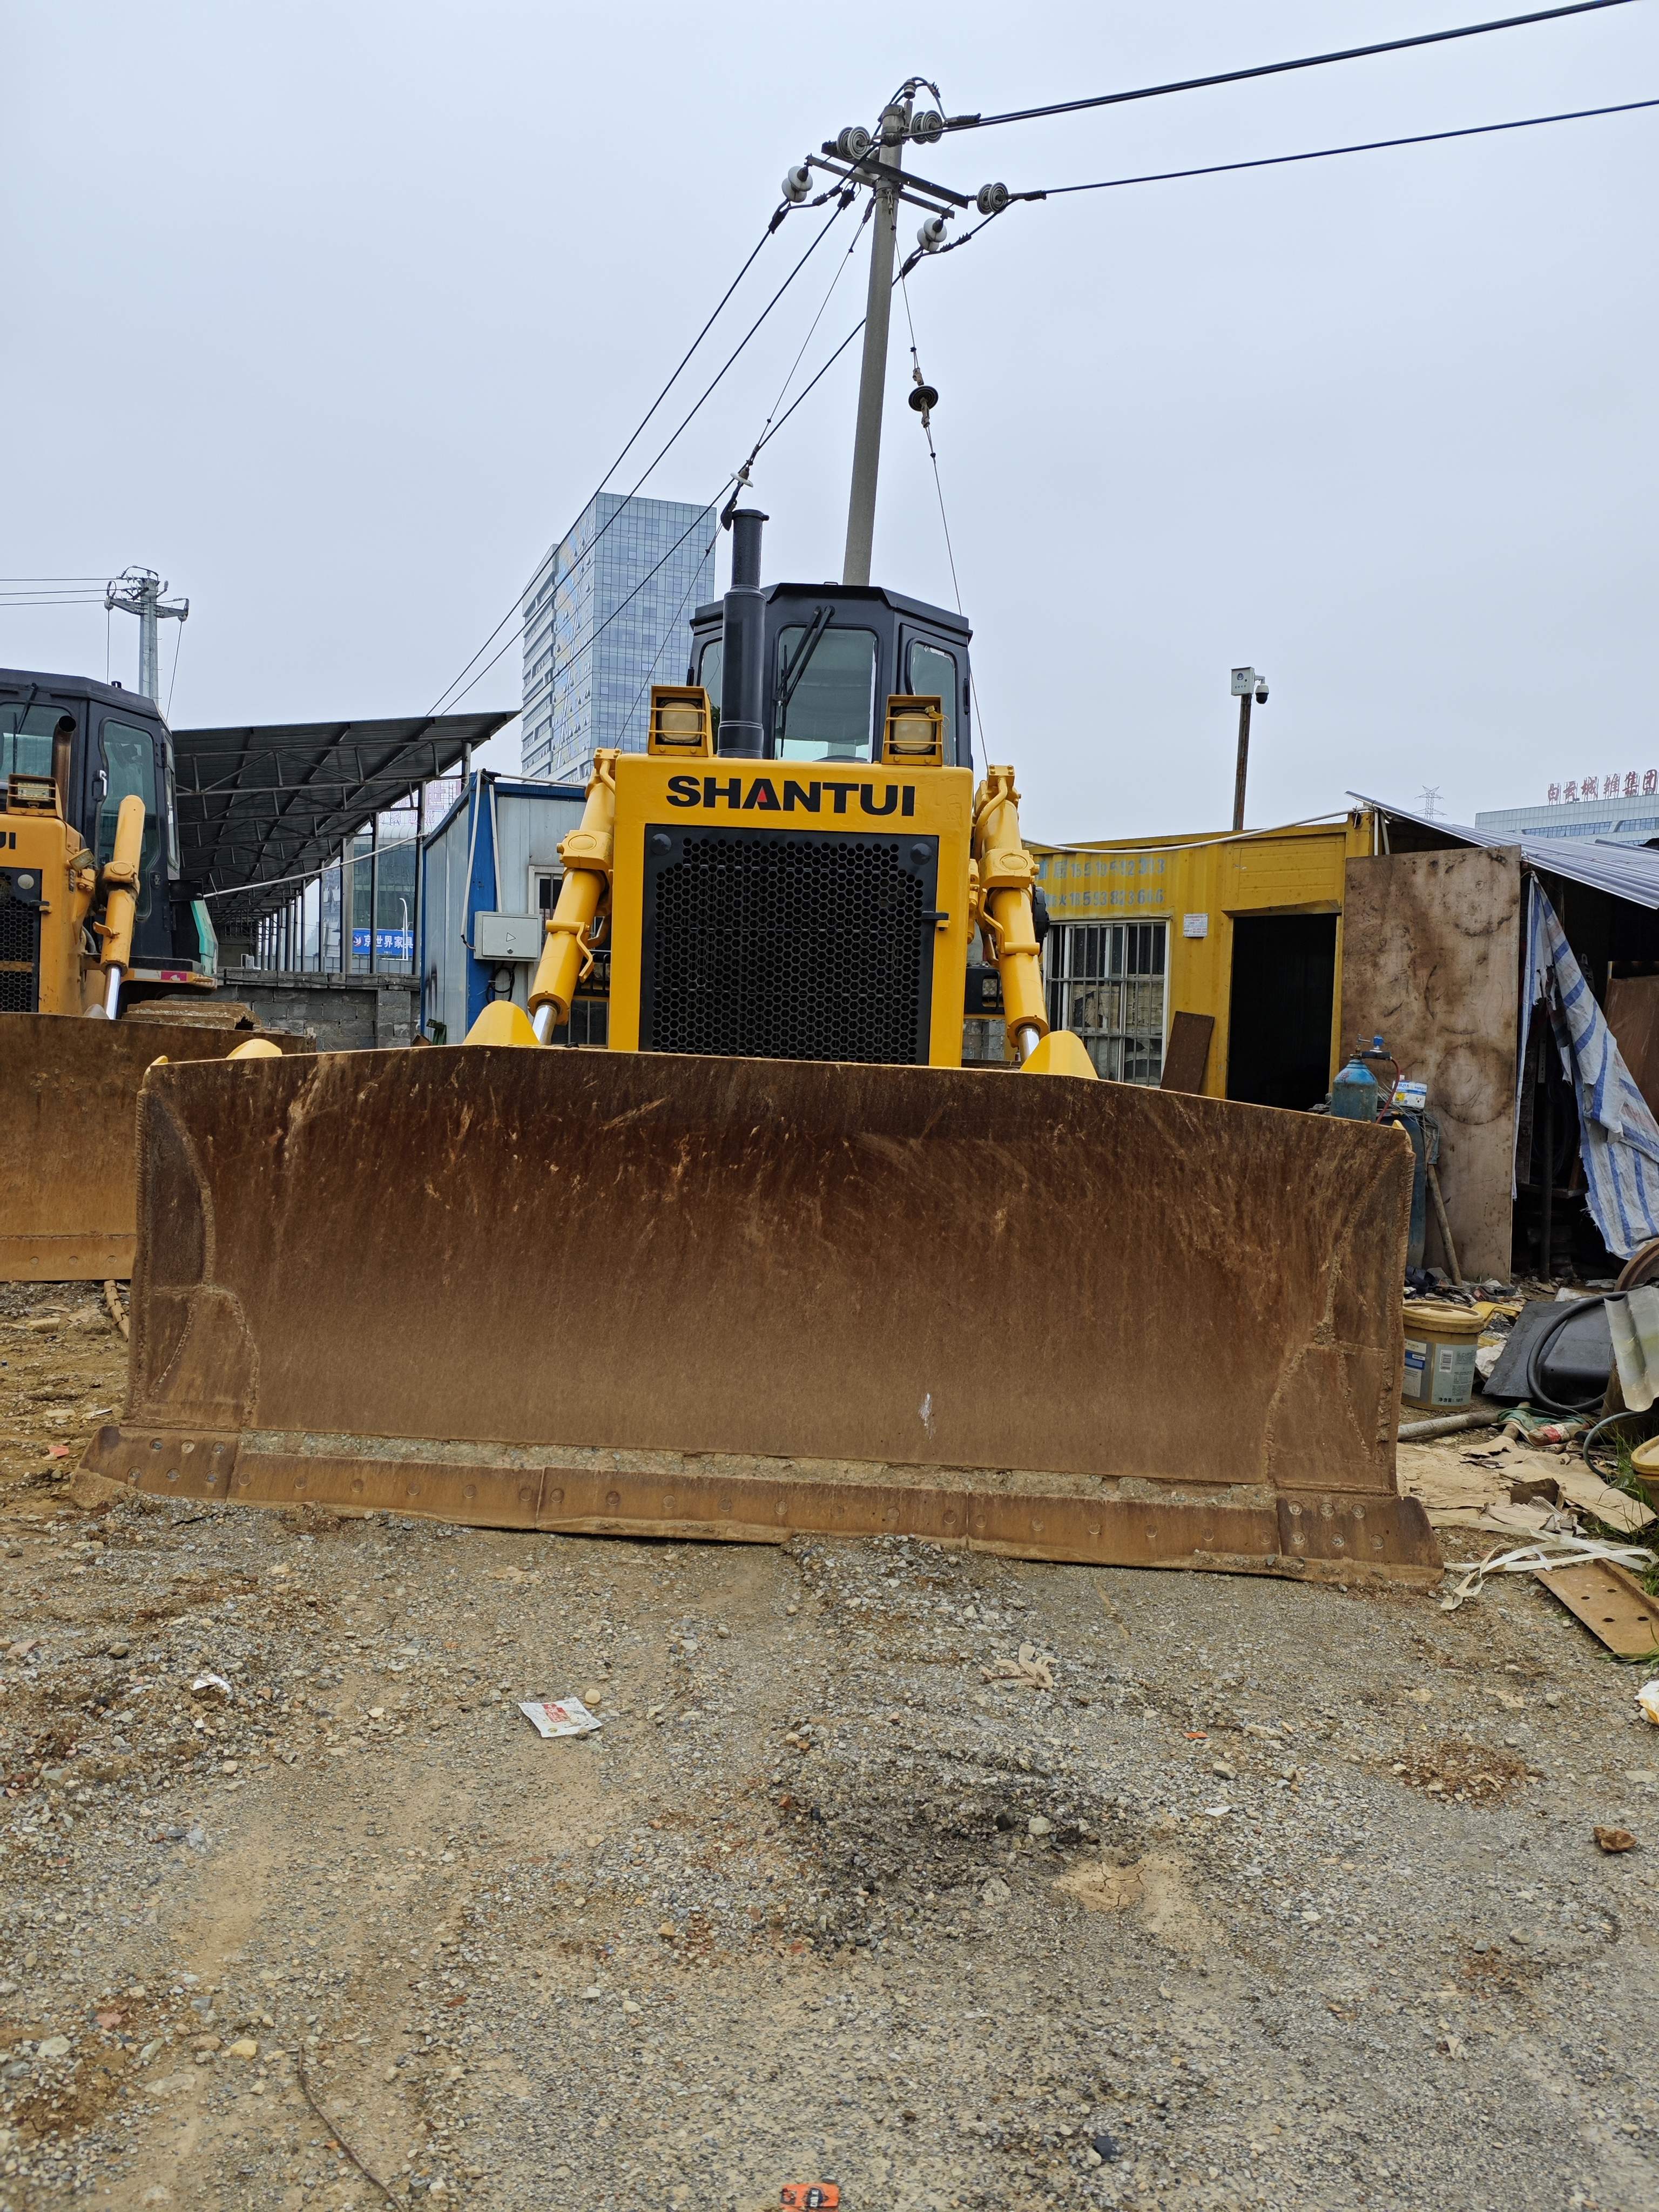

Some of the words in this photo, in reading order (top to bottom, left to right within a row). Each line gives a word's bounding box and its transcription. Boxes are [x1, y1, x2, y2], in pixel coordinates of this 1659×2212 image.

[666, 775, 915, 817] SHANTUI
[1548, 769, 1657, 801] 白云城维集团
